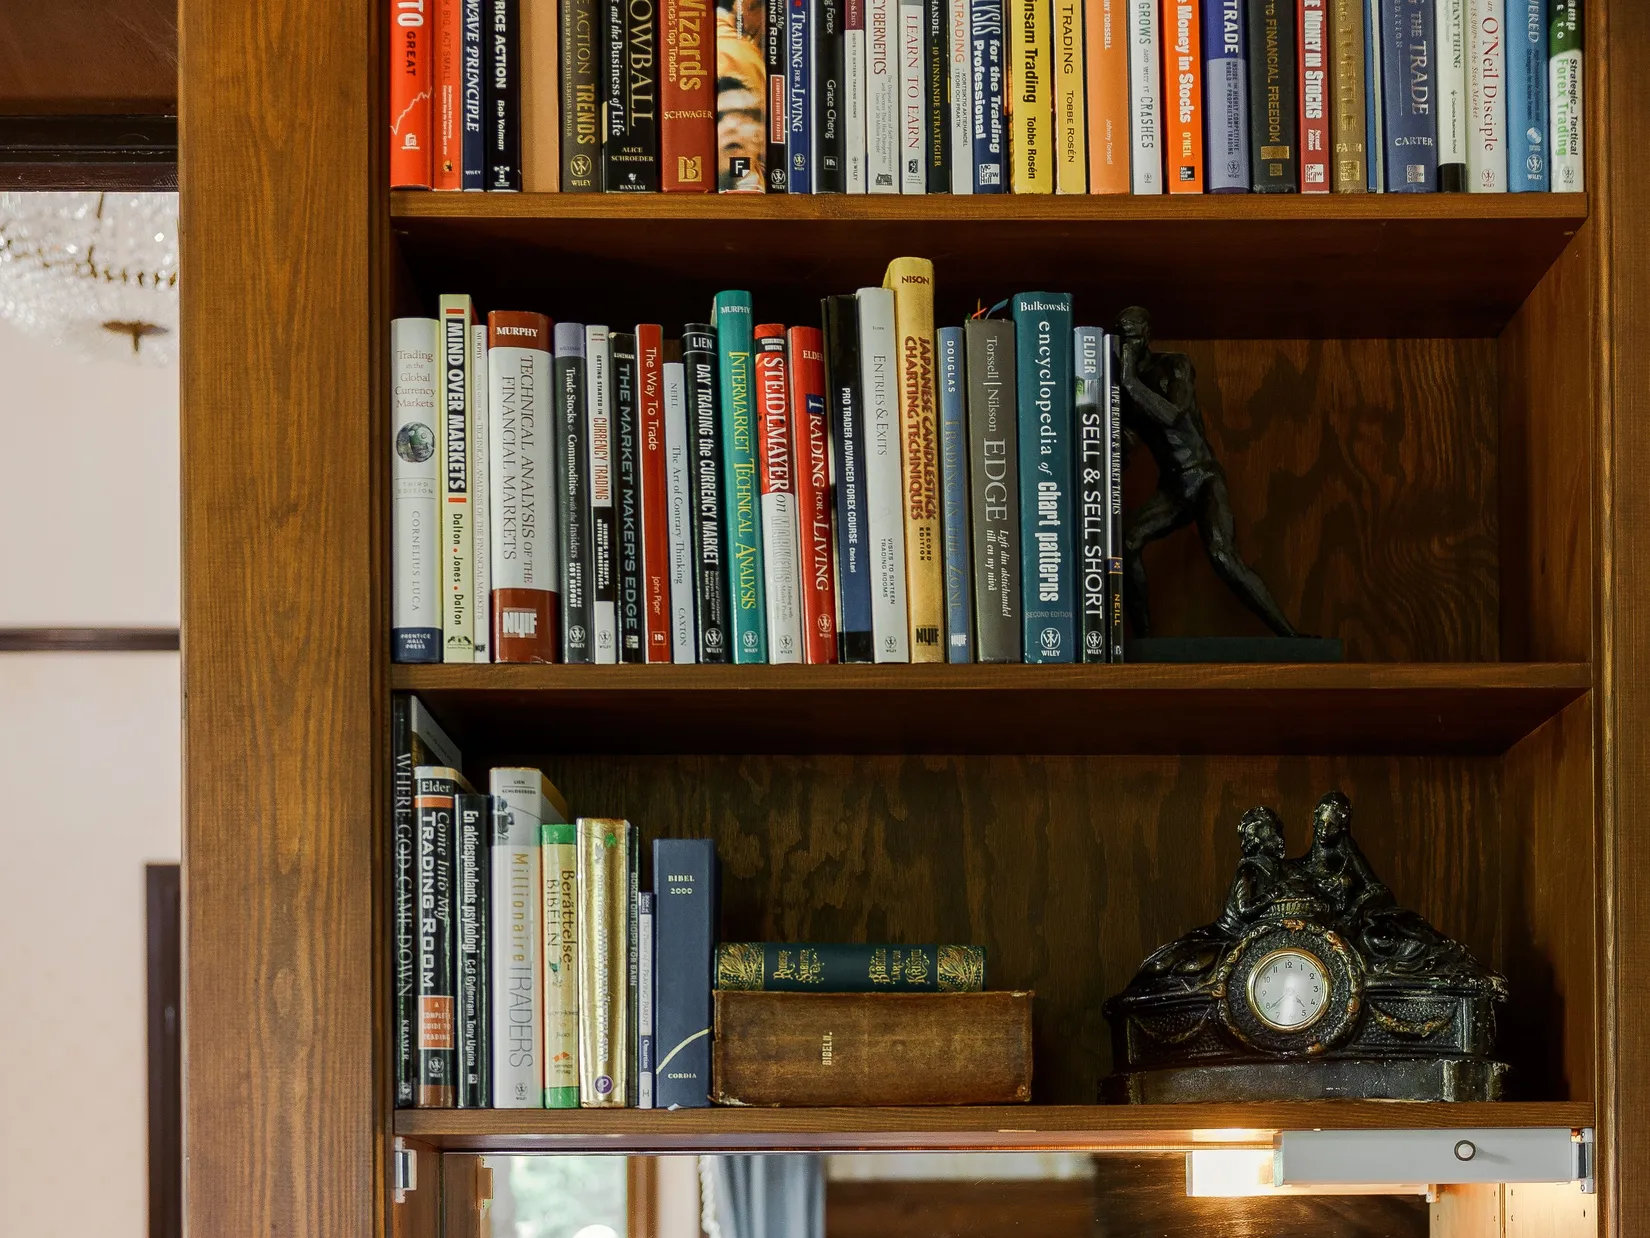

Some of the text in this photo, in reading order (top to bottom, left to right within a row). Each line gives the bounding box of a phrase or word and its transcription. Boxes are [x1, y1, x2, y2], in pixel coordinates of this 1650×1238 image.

[466, 0, 479, 132] WAVE PRINCIPLE
[610, 6, 624, 136] and the Business of Life
[666, 28, 678, 82] Top Traders
[769, 27, 778, 65] ROOM
[827, 8, 835, 34] Forex
[1063, 4, 1074, 74] TRADING
[1175, 6, 1194, 123] Money in Stocks
[1224, 2, 1238, 53] TRADE
[576, 7, 595, 144] ACTION TRENDS
[664, 110, 713, 119] SCHWAGER
[825, 80, 837, 139] Grace Cheng
[906, 15, 920, 150] LEARN TO EARN
[973, 40, 986, 139] Professional
[989, 40, 1000, 153] for the Trading
[1555, 59, 1569, 156] Forex Trading
[1569, 59, 1578, 155] Strategic Tactical
[497, 119, 505, 150] Volman
[1027, 117, 1037, 179] Tobbe Rosén
[1066, 91, 1076, 163] TOBBE ROSÉN
[1394, 137, 1433, 146] CARTER
[644, 347, 659, 450] The Way To Trade
[946, 340, 955, 393] DOUGLAS
[985, 336, 999, 432] Torssell Nilsson
[1082, 335, 1096, 374] ELDER
[447, 322, 465, 490] MIND OVER MARKETS
[905, 335, 923, 520] CHARTING TECHNIQUES
[919, 337, 936, 520] JAPANESE CANDLESTICK
[501, 375, 517, 560] FINANCIAL MARKETS
[520, 355, 535, 583] TECHNICAL ANALYSIS OF THE
[619, 364, 637, 629] THE MARKET MAKER'S EDGE
[696, 364, 718, 565] DAY TRADING the CURRENCY MARKET
[728, 351, 757, 610] INTERMARKET TECHNICAL ANALYSIS
[842, 388, 858, 544] PRO TRADER ADVANCED FOREX COURSE
[983, 437, 1008, 522] EDGE
[1035, 321, 1061, 602] encyclopedia of chart patterns
[671, 446, 685, 584] The Art of Contrary Thinking
[985, 529, 998, 591] till en ny nivå
[1082, 413, 1103, 619] SELL & SELL SHORT
[452, 514, 464, 626] Dalton Jones Dalton
[887, 538, 896, 605] VISITS TO SIXTEEN
[999, 529, 1012, 617] Lyft din aktiehandel
[421, 781, 451, 793] Elder
[396, 753, 413, 998] WHERE GOD CAME DOWN
[422, 812, 437, 987] TRADING ROOM
[434, 812, 450, 922] Come Into My
[461, 811, 479, 954] En aktiespekulants psykologi
[546, 879, 559, 947] BIBELN
[509, 853, 533, 1068] Millionaire TRADERS
[561, 870, 576, 971] Berättelse-
[401, 1019, 409, 1060] KRAMER
